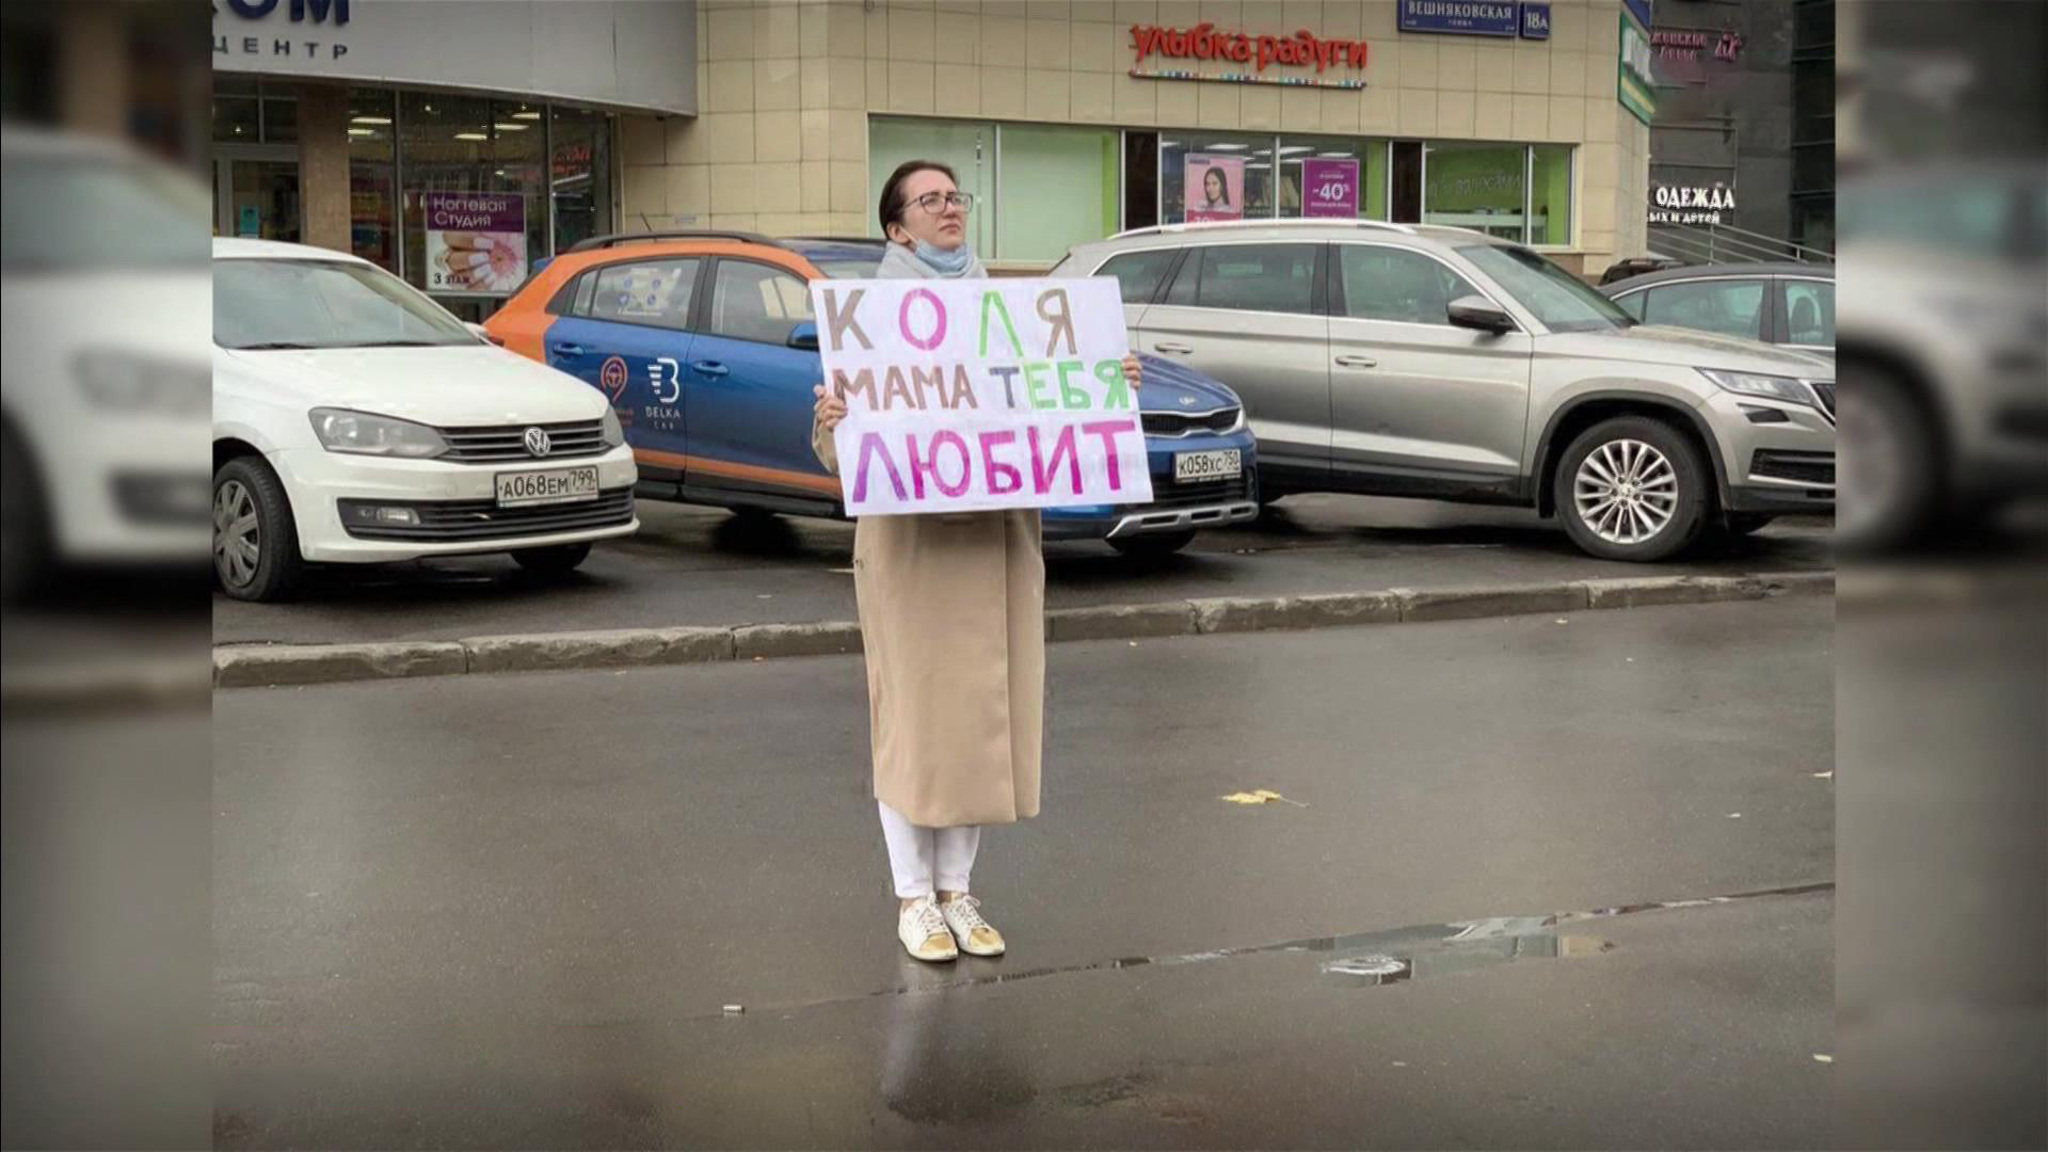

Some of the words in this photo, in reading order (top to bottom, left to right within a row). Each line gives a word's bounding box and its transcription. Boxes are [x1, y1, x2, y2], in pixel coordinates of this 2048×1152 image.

[1408, 1, 1512, 19] ВЕШНЯКОВСКАЯ
[433, 197, 507, 212] Ногтевая
[1656, 186, 1735, 209] ОДЕЖДА
[434, 211, 492, 228] Студия
[823, 288, 1077, 358] КОЛЯ
[832, 364, 978, 411] МАМА
[989, 359, 1130, 410] ТЕБЯ
[852, 420, 1135, 503] ЛЮБИТ
